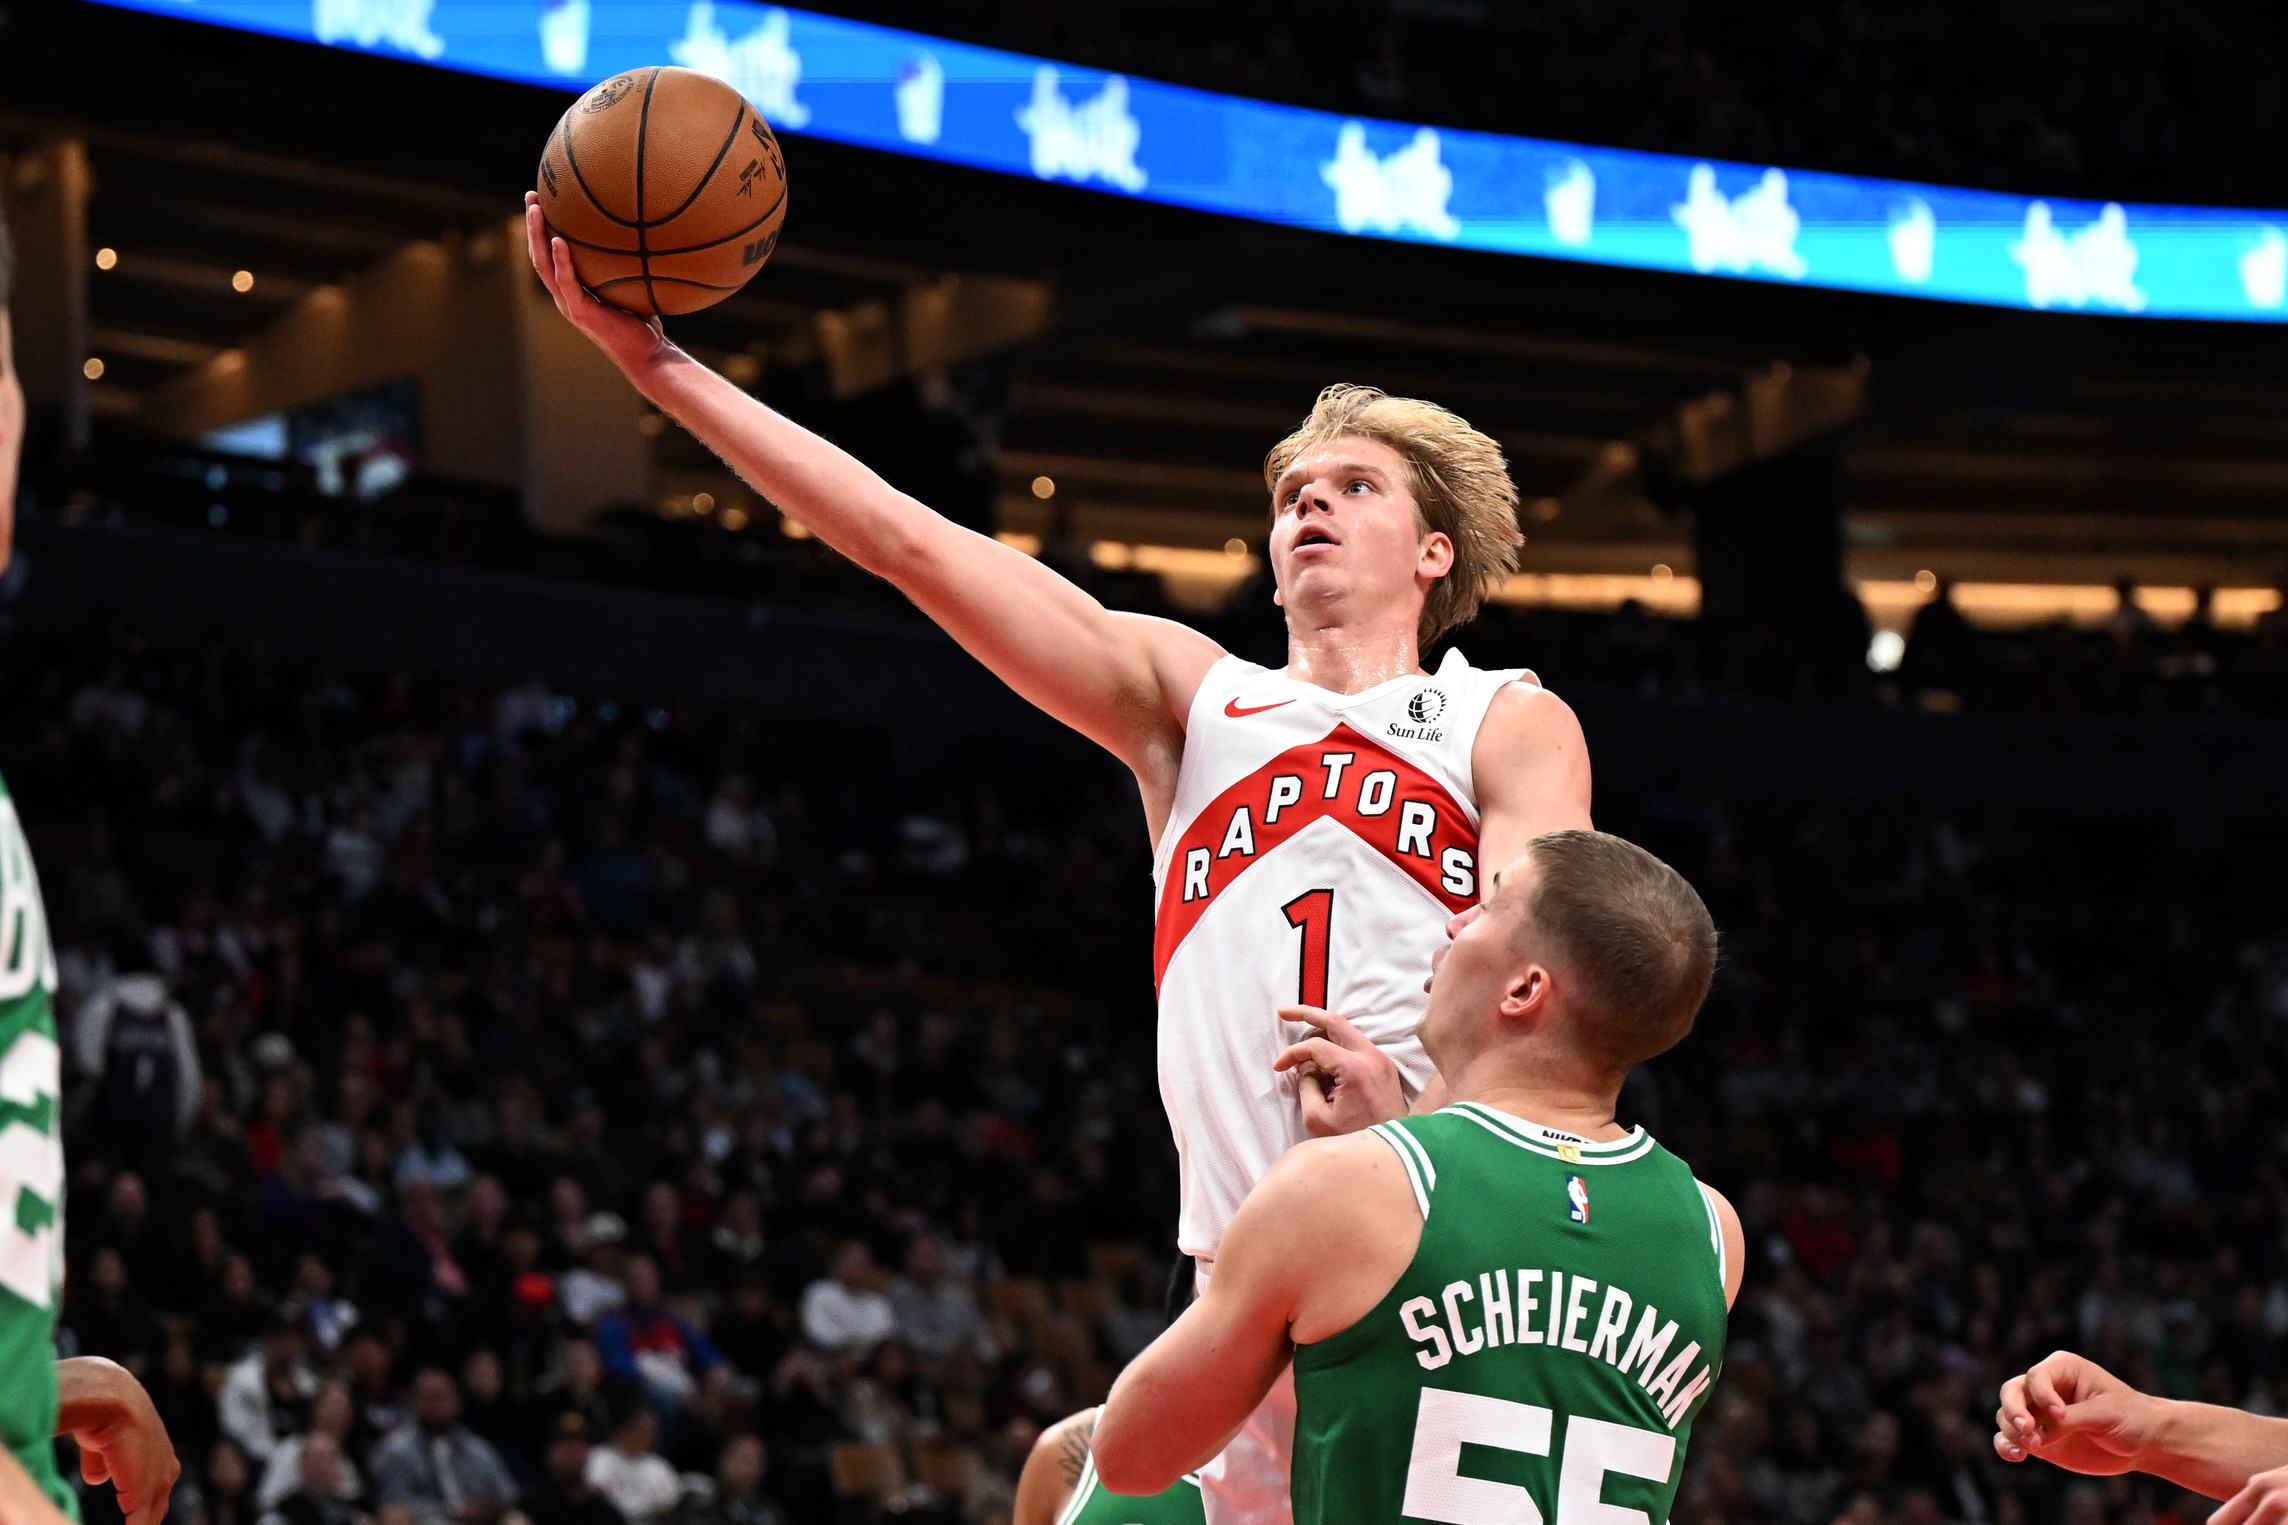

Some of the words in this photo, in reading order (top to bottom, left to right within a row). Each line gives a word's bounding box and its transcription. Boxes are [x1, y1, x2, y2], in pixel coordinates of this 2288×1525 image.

[1387, 723, 1415, 739] Sun
[1416, 727, 1443, 742] Life
[1182, 752, 1478, 903] RAPTORS
[1280, 888, 1334, 1011] 1
[1399, 1268, 1711, 1431] SCHEIERMAN
